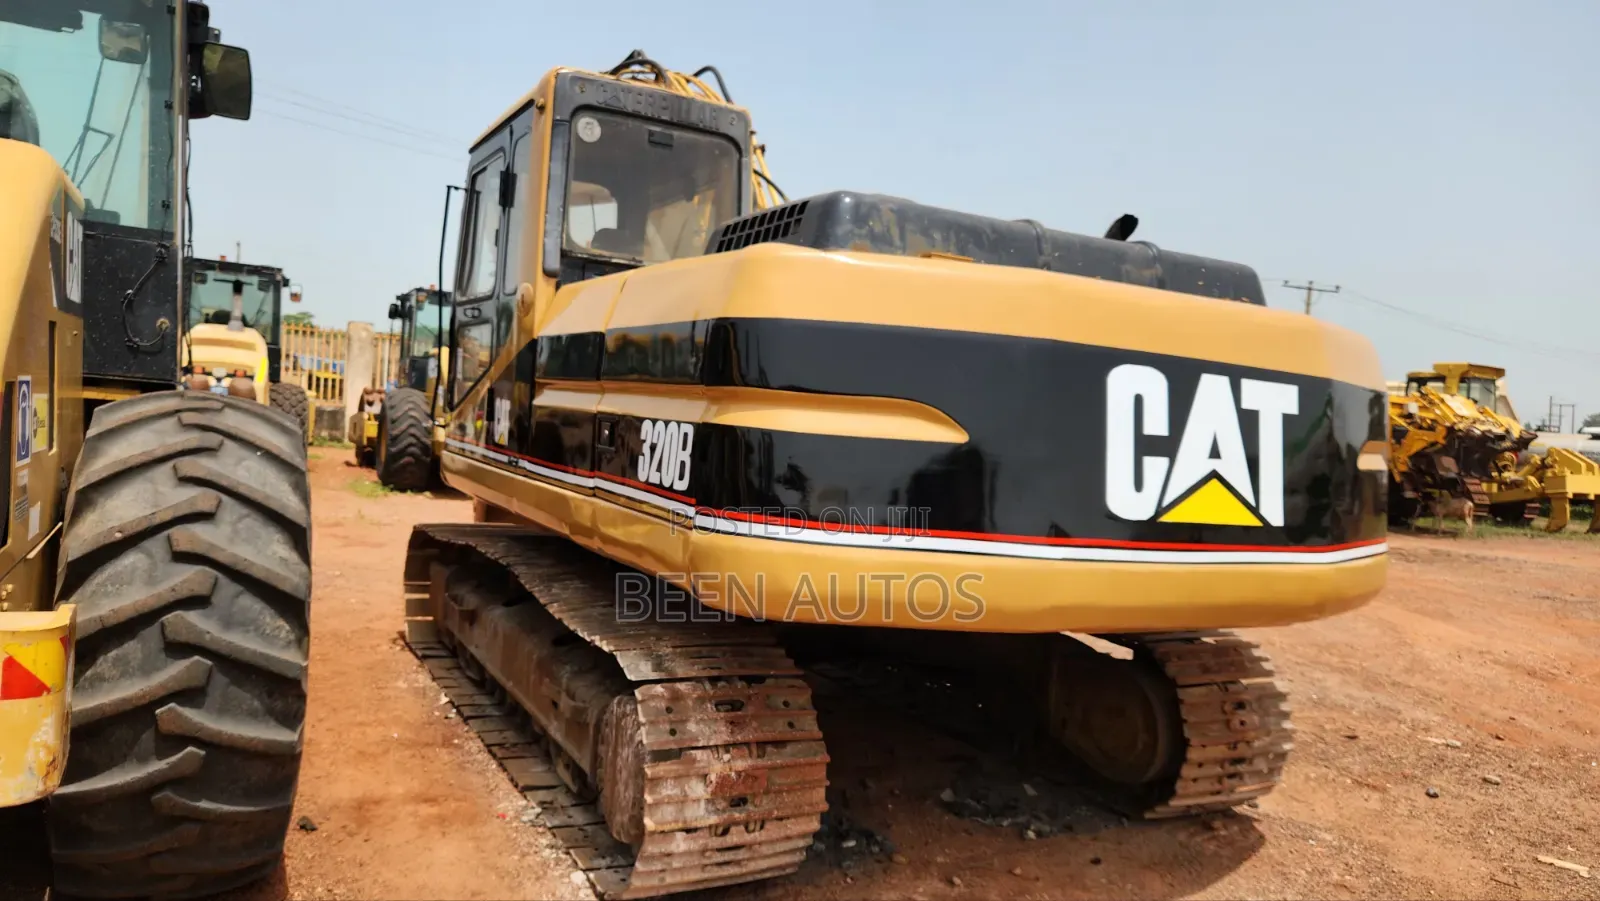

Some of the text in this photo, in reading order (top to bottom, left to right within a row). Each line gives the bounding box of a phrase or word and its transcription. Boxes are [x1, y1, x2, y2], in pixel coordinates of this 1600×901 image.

[596, 83, 720, 131] CATERPILLAR
[66, 211, 84, 304] CAT
[637, 418, 695, 491] 320B
[1106, 363, 1300, 528] CAT
